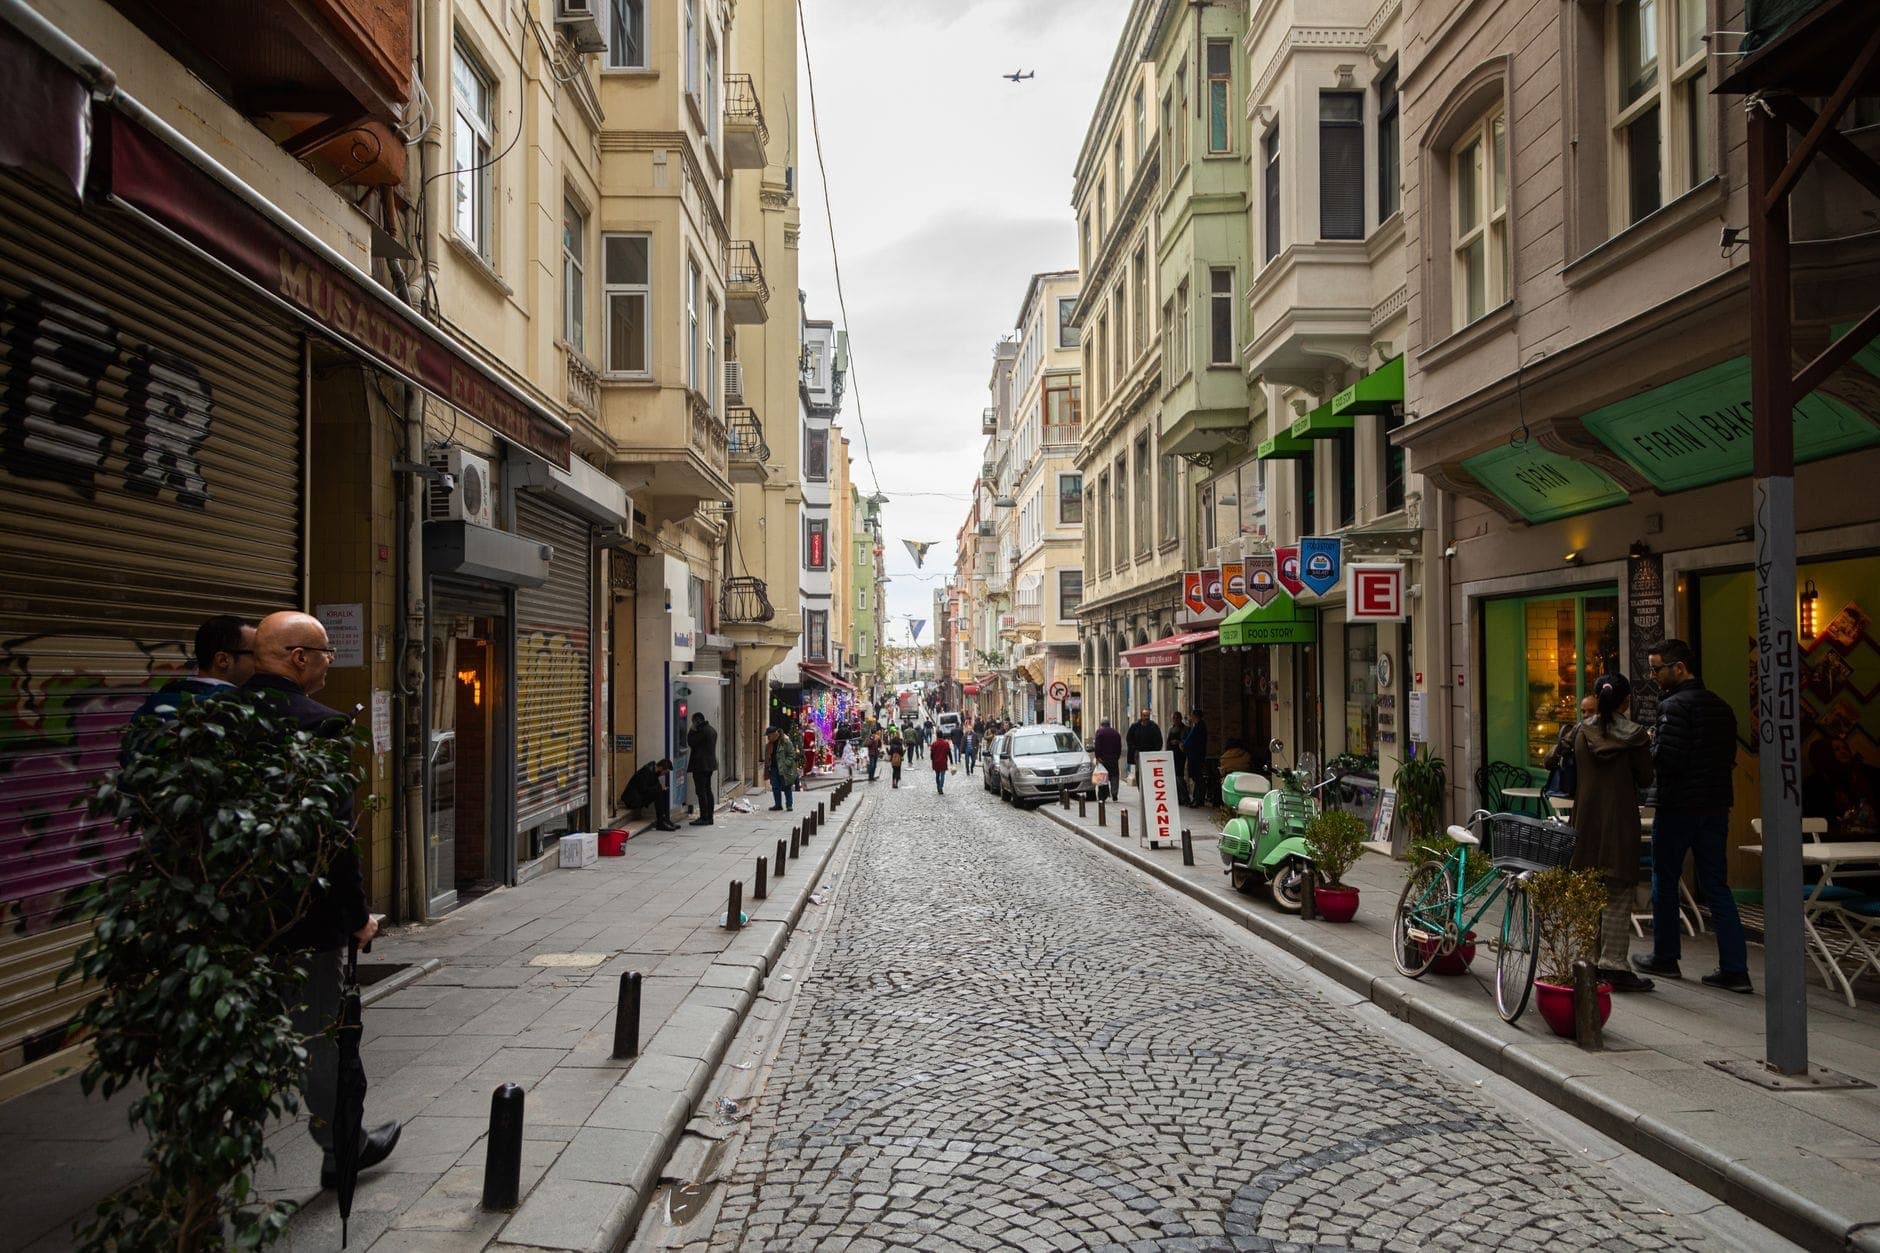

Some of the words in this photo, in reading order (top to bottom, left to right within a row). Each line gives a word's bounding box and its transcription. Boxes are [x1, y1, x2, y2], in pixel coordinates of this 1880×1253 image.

[278, 247, 422, 381] MUSATEK
[1633, 423, 1707, 461] FIRIN
[1364, 576, 1392, 609] E
[1248, 629, 1268, 639] FOOD
[1270, 628, 1294, 638] STORY
[1152, 767, 1170, 837] ECZANE
